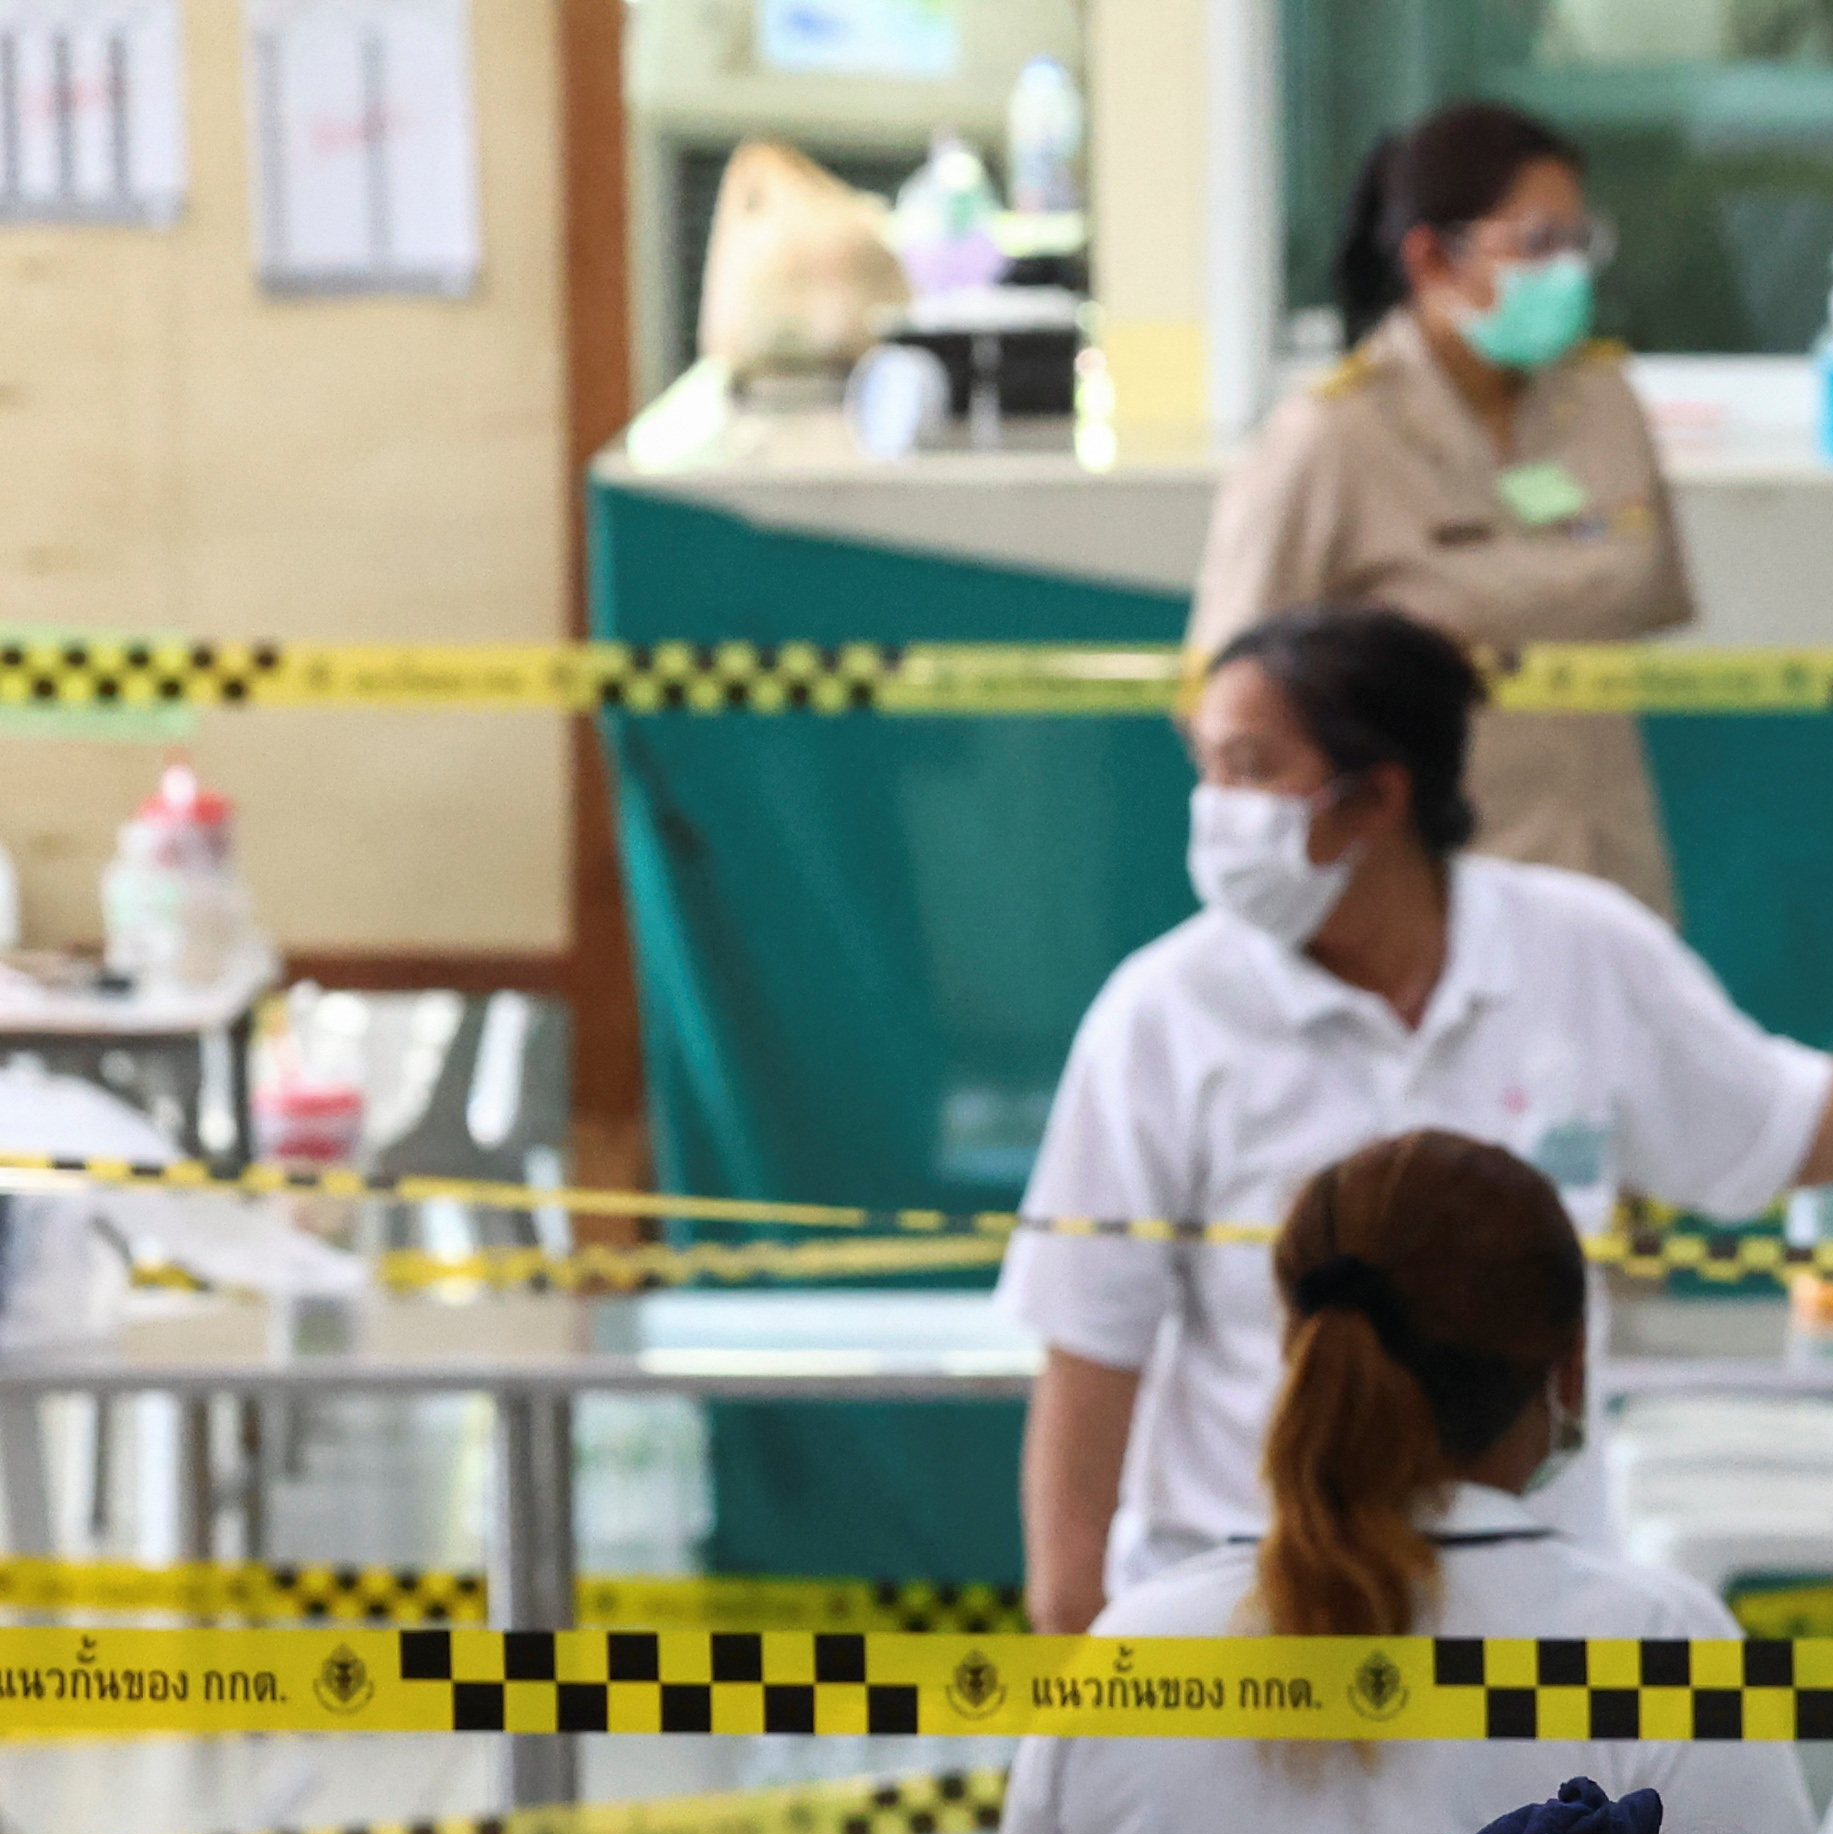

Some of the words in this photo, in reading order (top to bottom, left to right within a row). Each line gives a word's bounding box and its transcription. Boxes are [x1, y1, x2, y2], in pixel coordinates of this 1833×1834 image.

[203, 1669, 288, 1703] กกต.
[1031, 1645, 1225, 1710] แนวกั้นของ
[1239, 1676, 1323, 1710] กกต.
